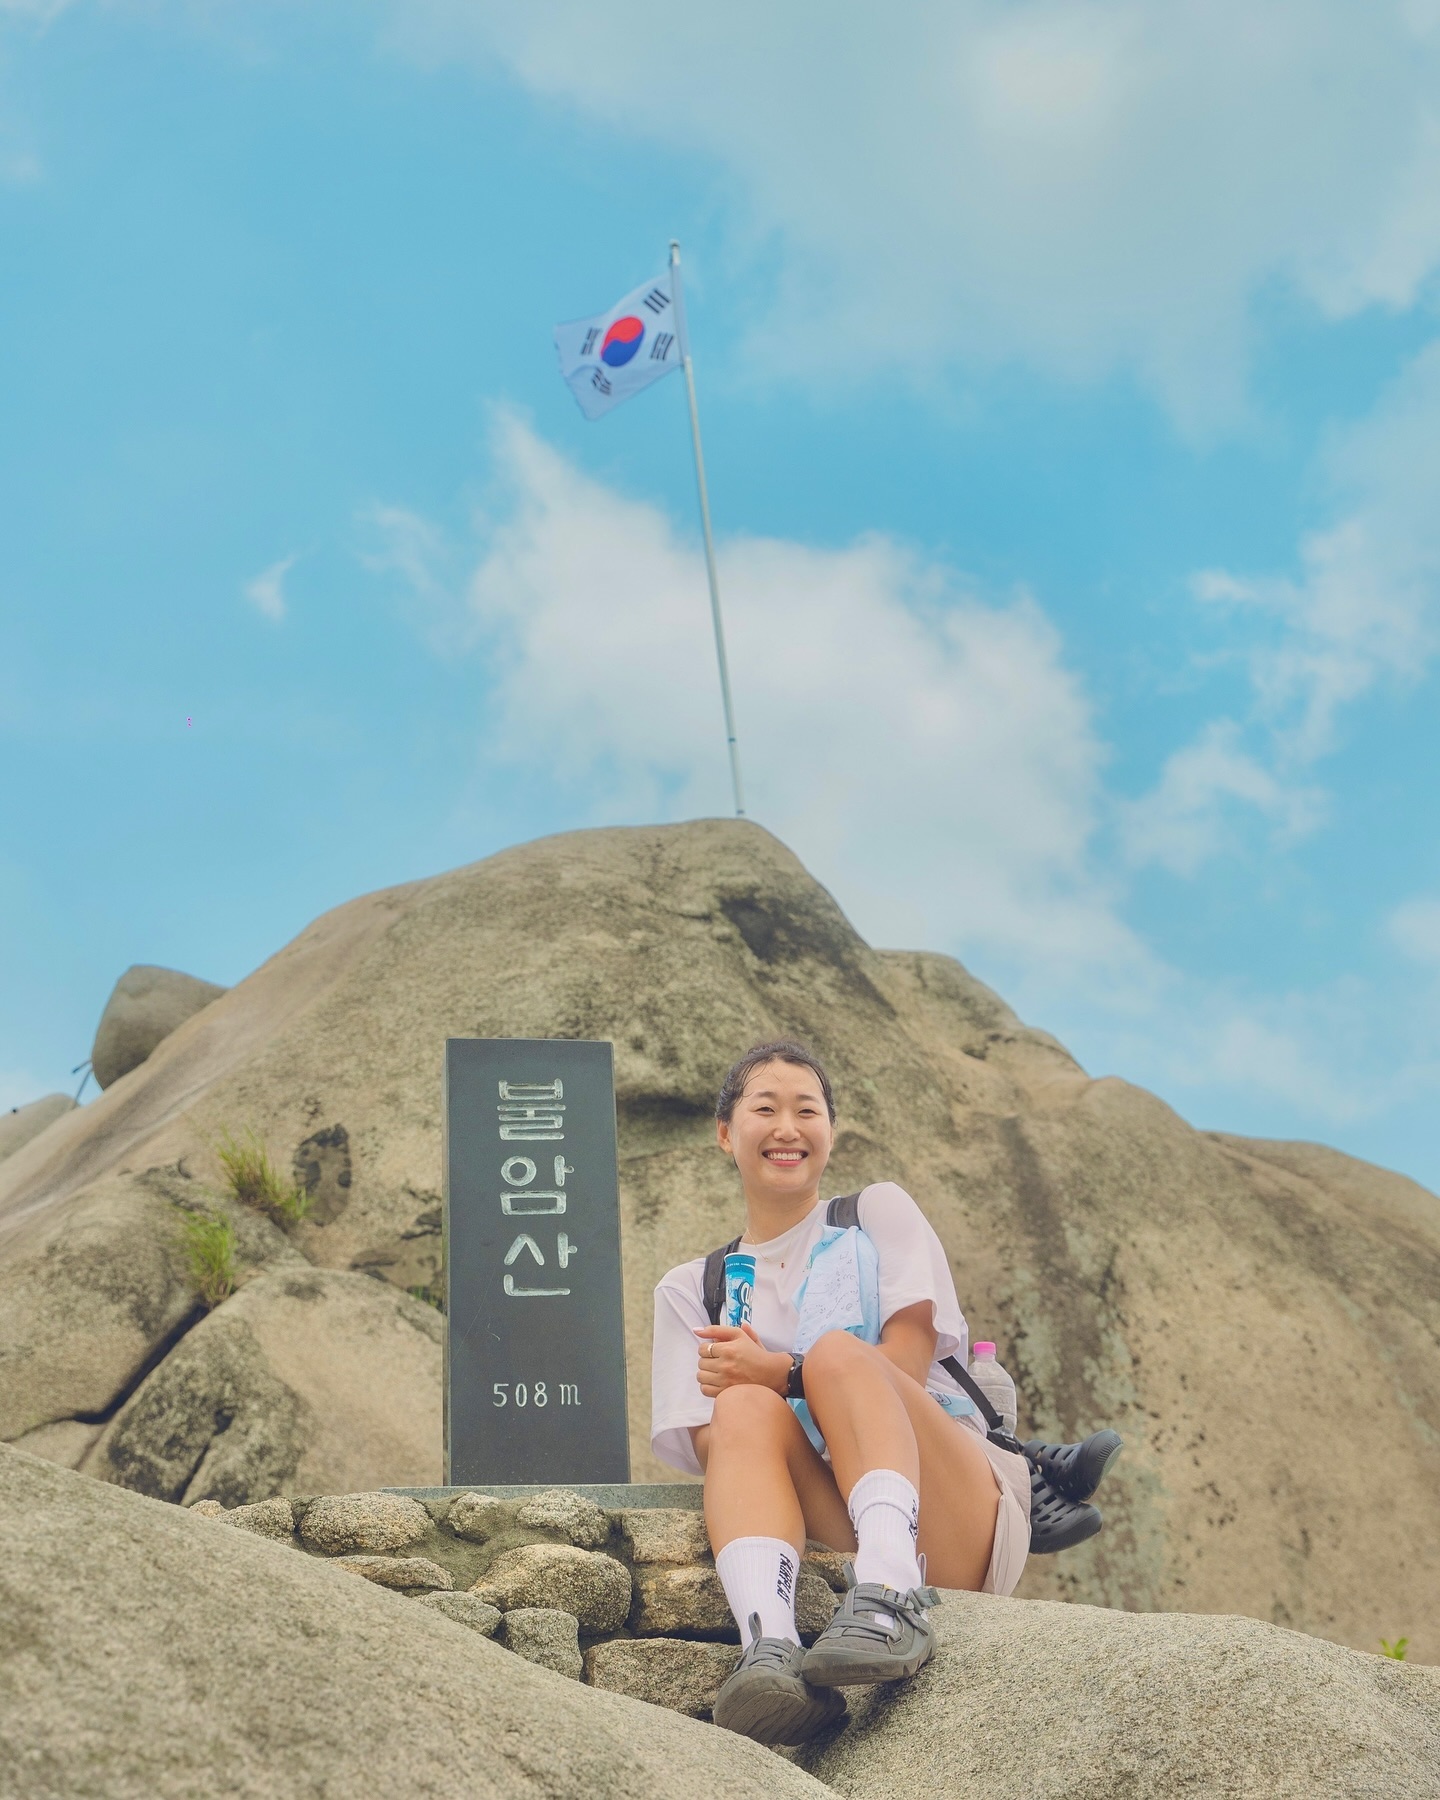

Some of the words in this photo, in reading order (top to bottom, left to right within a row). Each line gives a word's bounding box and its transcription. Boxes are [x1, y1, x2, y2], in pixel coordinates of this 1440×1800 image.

[497, 1078, 578, 1297] 불암산
[492, 1382, 548, 1407] 508
[559, 1383, 582, 1405] m
